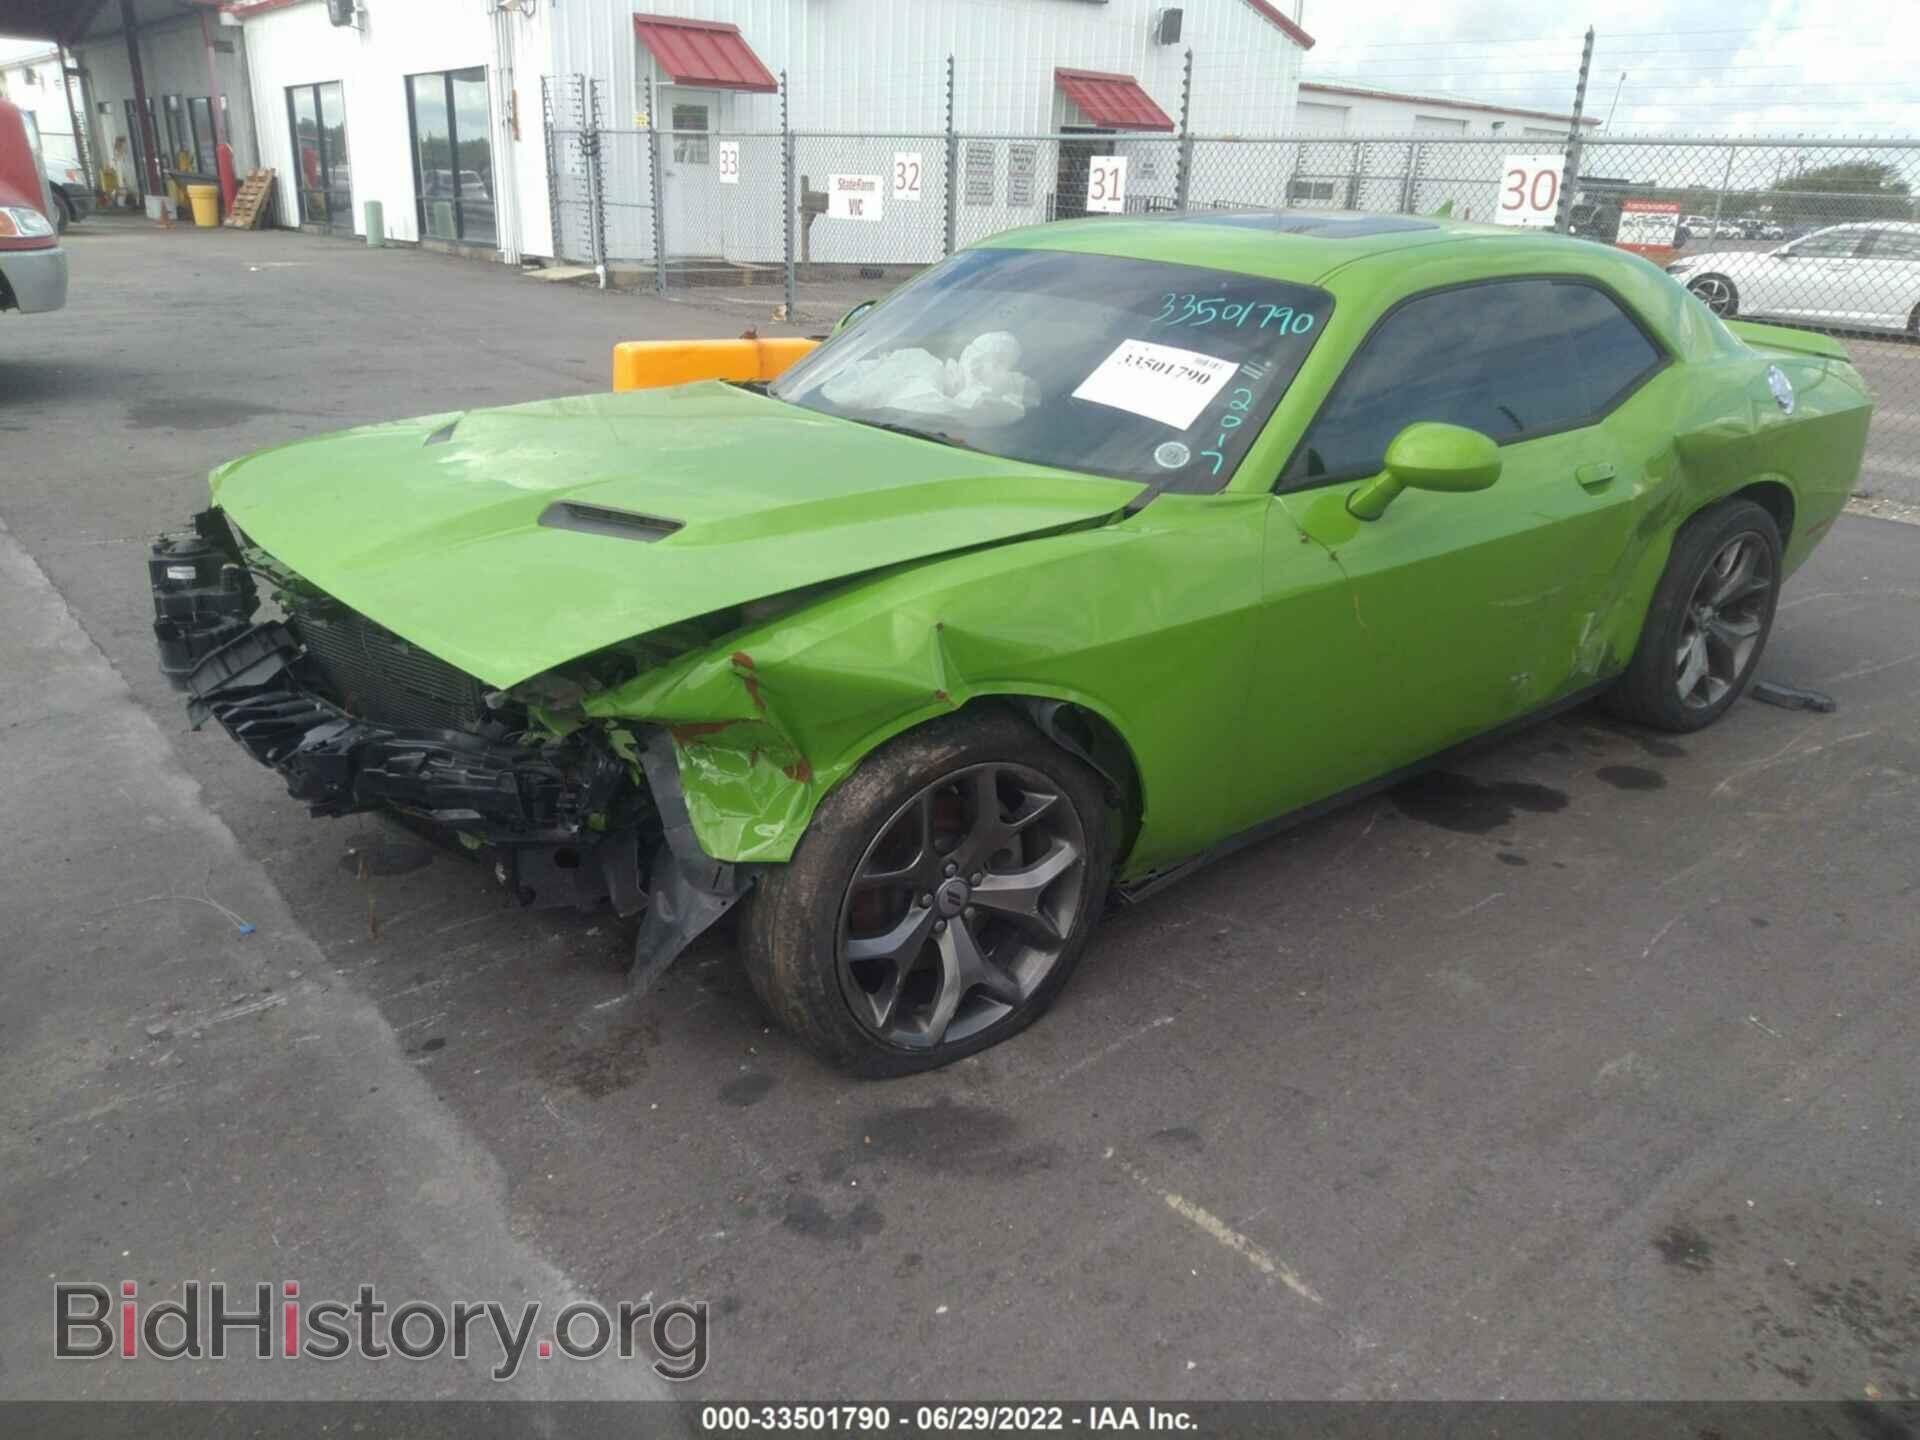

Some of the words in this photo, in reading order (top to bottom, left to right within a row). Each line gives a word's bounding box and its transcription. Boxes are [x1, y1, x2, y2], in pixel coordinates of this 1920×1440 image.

[720, 151, 738, 175] 33
[895, 162, 920, 191] 32
[1090, 168, 1121, 201] 31
[1502, 169, 1558, 212] 30
[848, 198, 864, 216] VIC
[1150, 292, 1315, 336] 33501790
